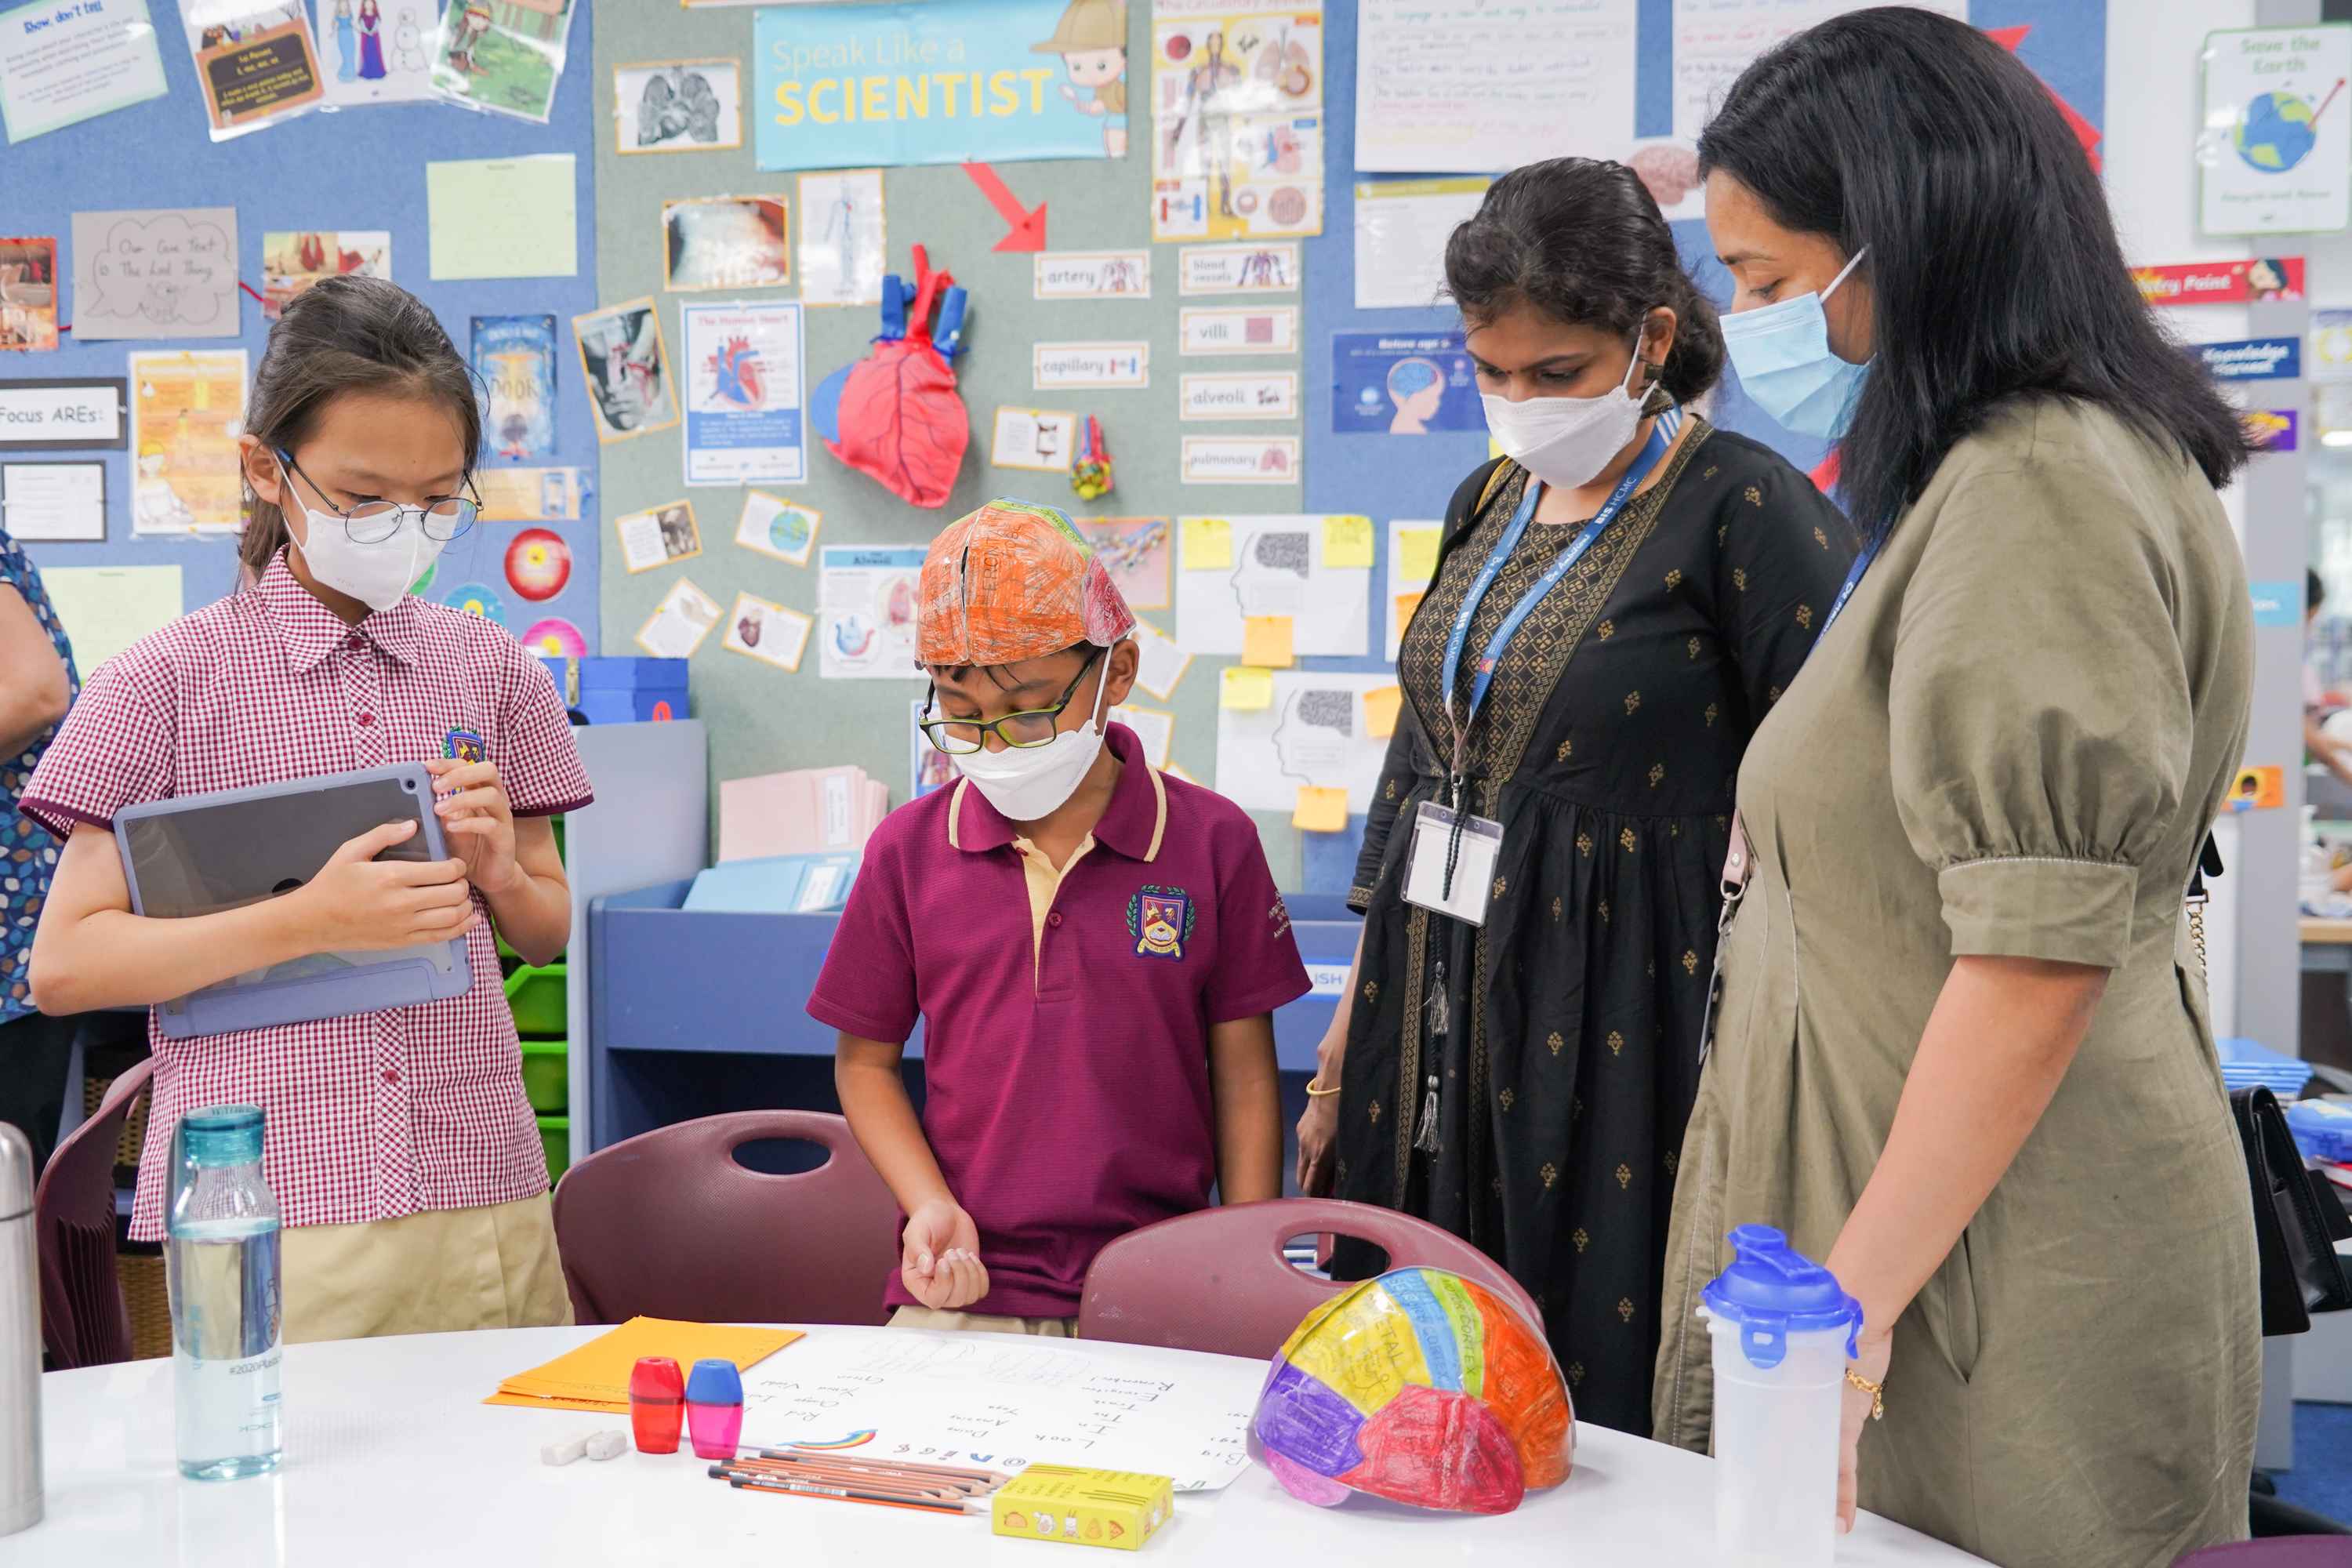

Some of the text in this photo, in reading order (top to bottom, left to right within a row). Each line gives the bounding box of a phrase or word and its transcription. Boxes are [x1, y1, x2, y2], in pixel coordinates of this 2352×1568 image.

[55, 5, 82, 23] don't
[2241, 38, 2321, 53] Save the
[771, 33, 967, 77] Speak Like a
[2253, 57, 2307, 74] Earth
[773, 68, 1054, 126] SCIENTIST
[1192, 260, 1226, 271] blood
[1047, 270, 1094, 285] artery
[2183, 274, 2232, 291] Point
[1200, 323, 1229, 339] villi
[1044, 354, 1103, 376] capillary
[1193, 388, 1246, 405] alveoli
[0, 405, 104, 423] Focus AREs:
[1191, 452, 1256, 470] pulmonary
[1595, 507, 1614, 524] BIS
[1611, 477, 1638, 507] HCMC
[1456, 611, 1469, 630] BIS
[1459, 1313, 1479, 1376] CORTEX
[836, 1374, 884, 1385] Green
[784, 1410, 821, 1422] Red
[1034, 1433, 1097, 1450] Look
